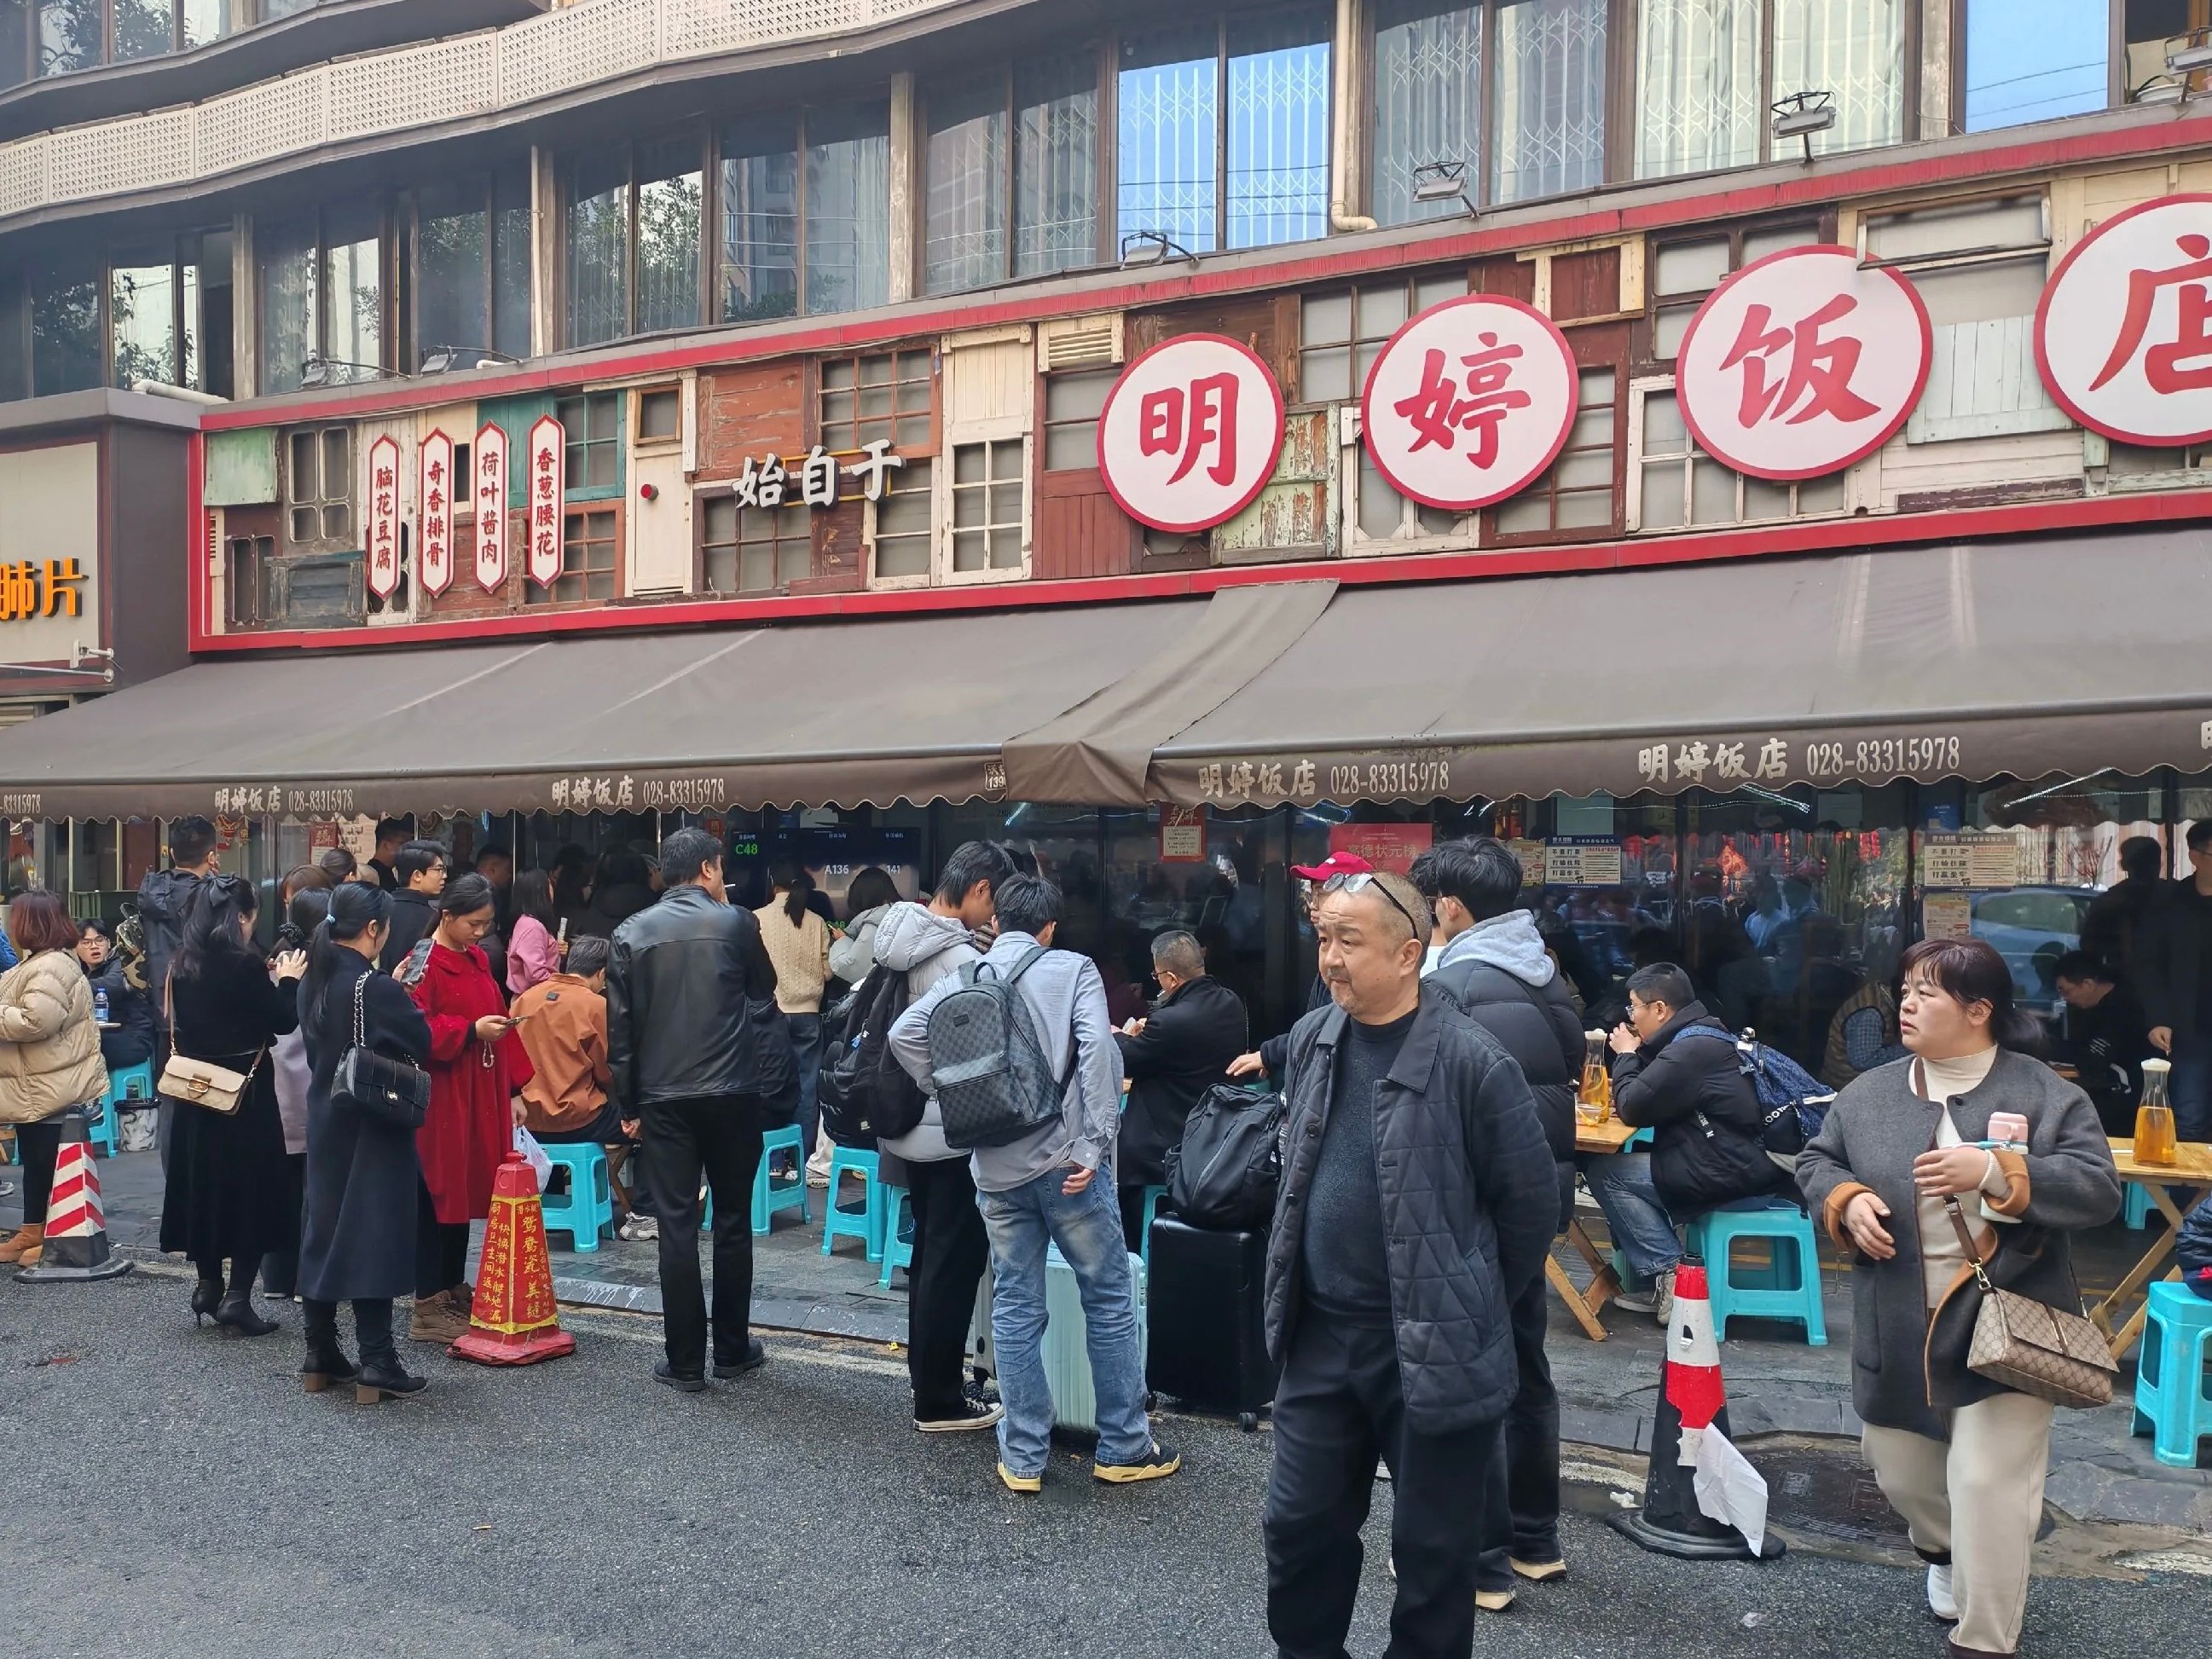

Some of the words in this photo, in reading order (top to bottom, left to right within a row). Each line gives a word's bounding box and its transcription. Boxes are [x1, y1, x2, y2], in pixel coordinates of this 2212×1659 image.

[1138, 234, 2212, 487] 明婷饭店
[535, 447, 556, 558] 香葱腰花
[732, 438, 902, 509] 始自于
[375, 466, 393, 570] 脑花豆腐
[426, 460, 445, 567] 奇香排骨
[481, 451, 500, 564] 荷叶酱肉
[0, 556, 83, 621] 肺片
[552, 775, 634, 807] 明婷饭店
[643, 778, 725, 805] 028-83315978
[989, 776, 1005, 789] 139
[1199, 759, 1316, 799] 明婷饭店
[1330, 761, 1450, 795] 028-83315978
[1638, 738, 1788, 783] 明婷饭店
[1806, 736, 1960, 777] 028-83315978
[215, 785, 281, 814] 明婷饭店
[288, 789, 353, 812] 028-83315978
[735, 843, 758, 855] C48
[825, 864, 849, 875] A136
[489, 1223, 512, 1323] 快换潜水艇地漏
